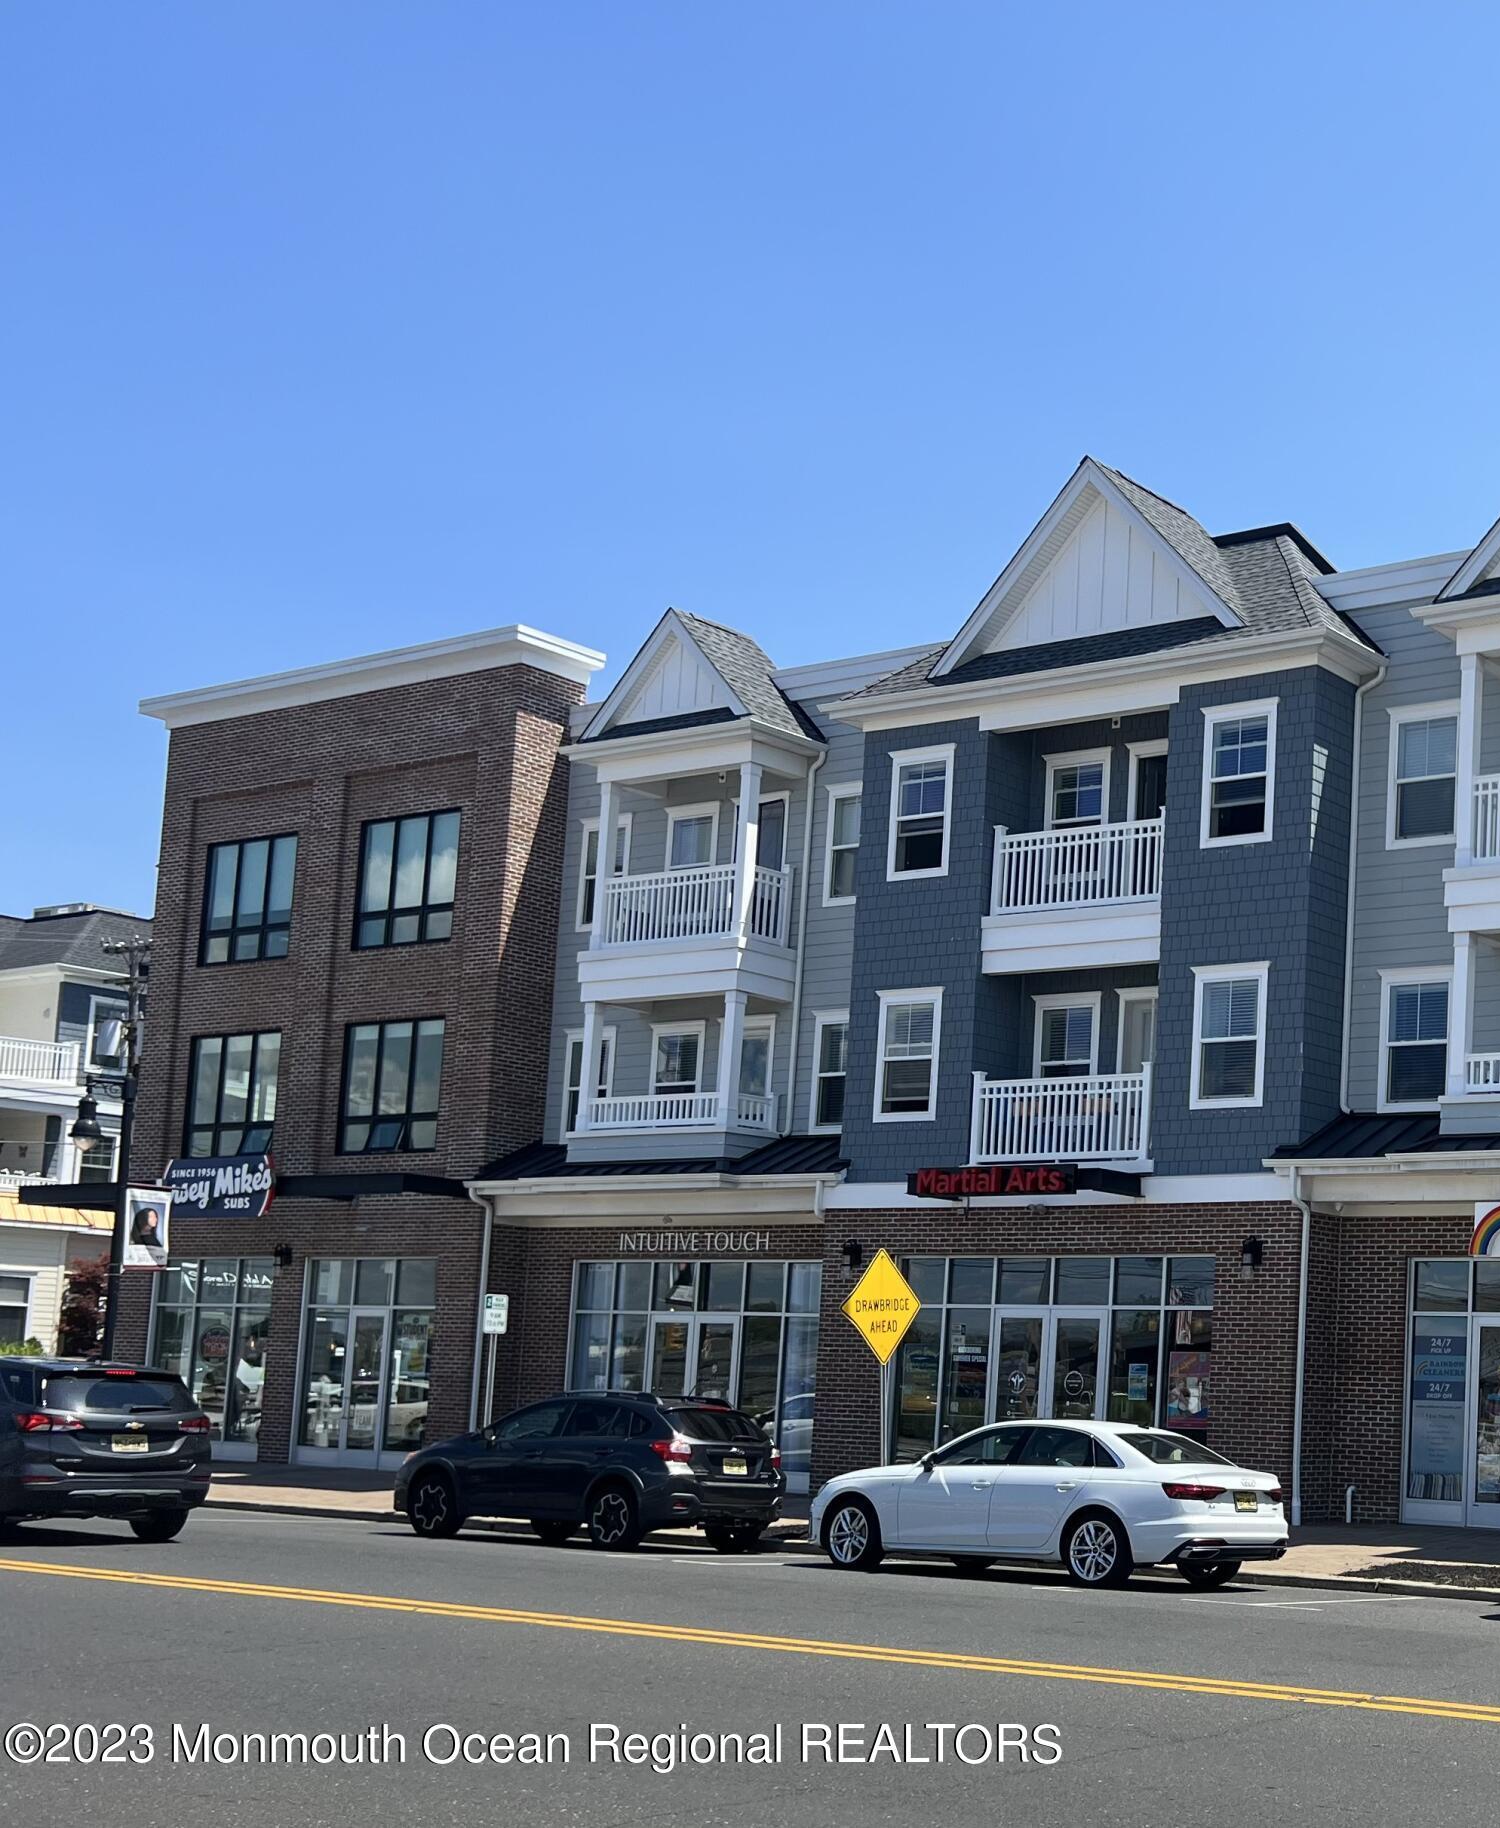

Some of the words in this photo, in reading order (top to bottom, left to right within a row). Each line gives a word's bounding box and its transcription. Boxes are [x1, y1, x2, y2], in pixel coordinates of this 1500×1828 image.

[172, 1169, 195, 1178] SINCE
[198, 1168, 216, 1177] 1956
[214, 1163, 272, 1198] Mike's
[916, 1167, 998, 1194] Martial
[1005, 1167, 1065, 1192] Arts
[224, 1197, 250, 1209] SUBS
[619, 1233, 700, 1251] INTUITIVE
[704, 1232, 770, 1251] TOUCH
[855, 1299, 910, 1313] DRAWBRIDGE
[870, 1320, 898, 1333] AHEAD
[1431, 1338, 1451, 1347] 24/7
[1429, 1383, 1450, 1392] 24/7
